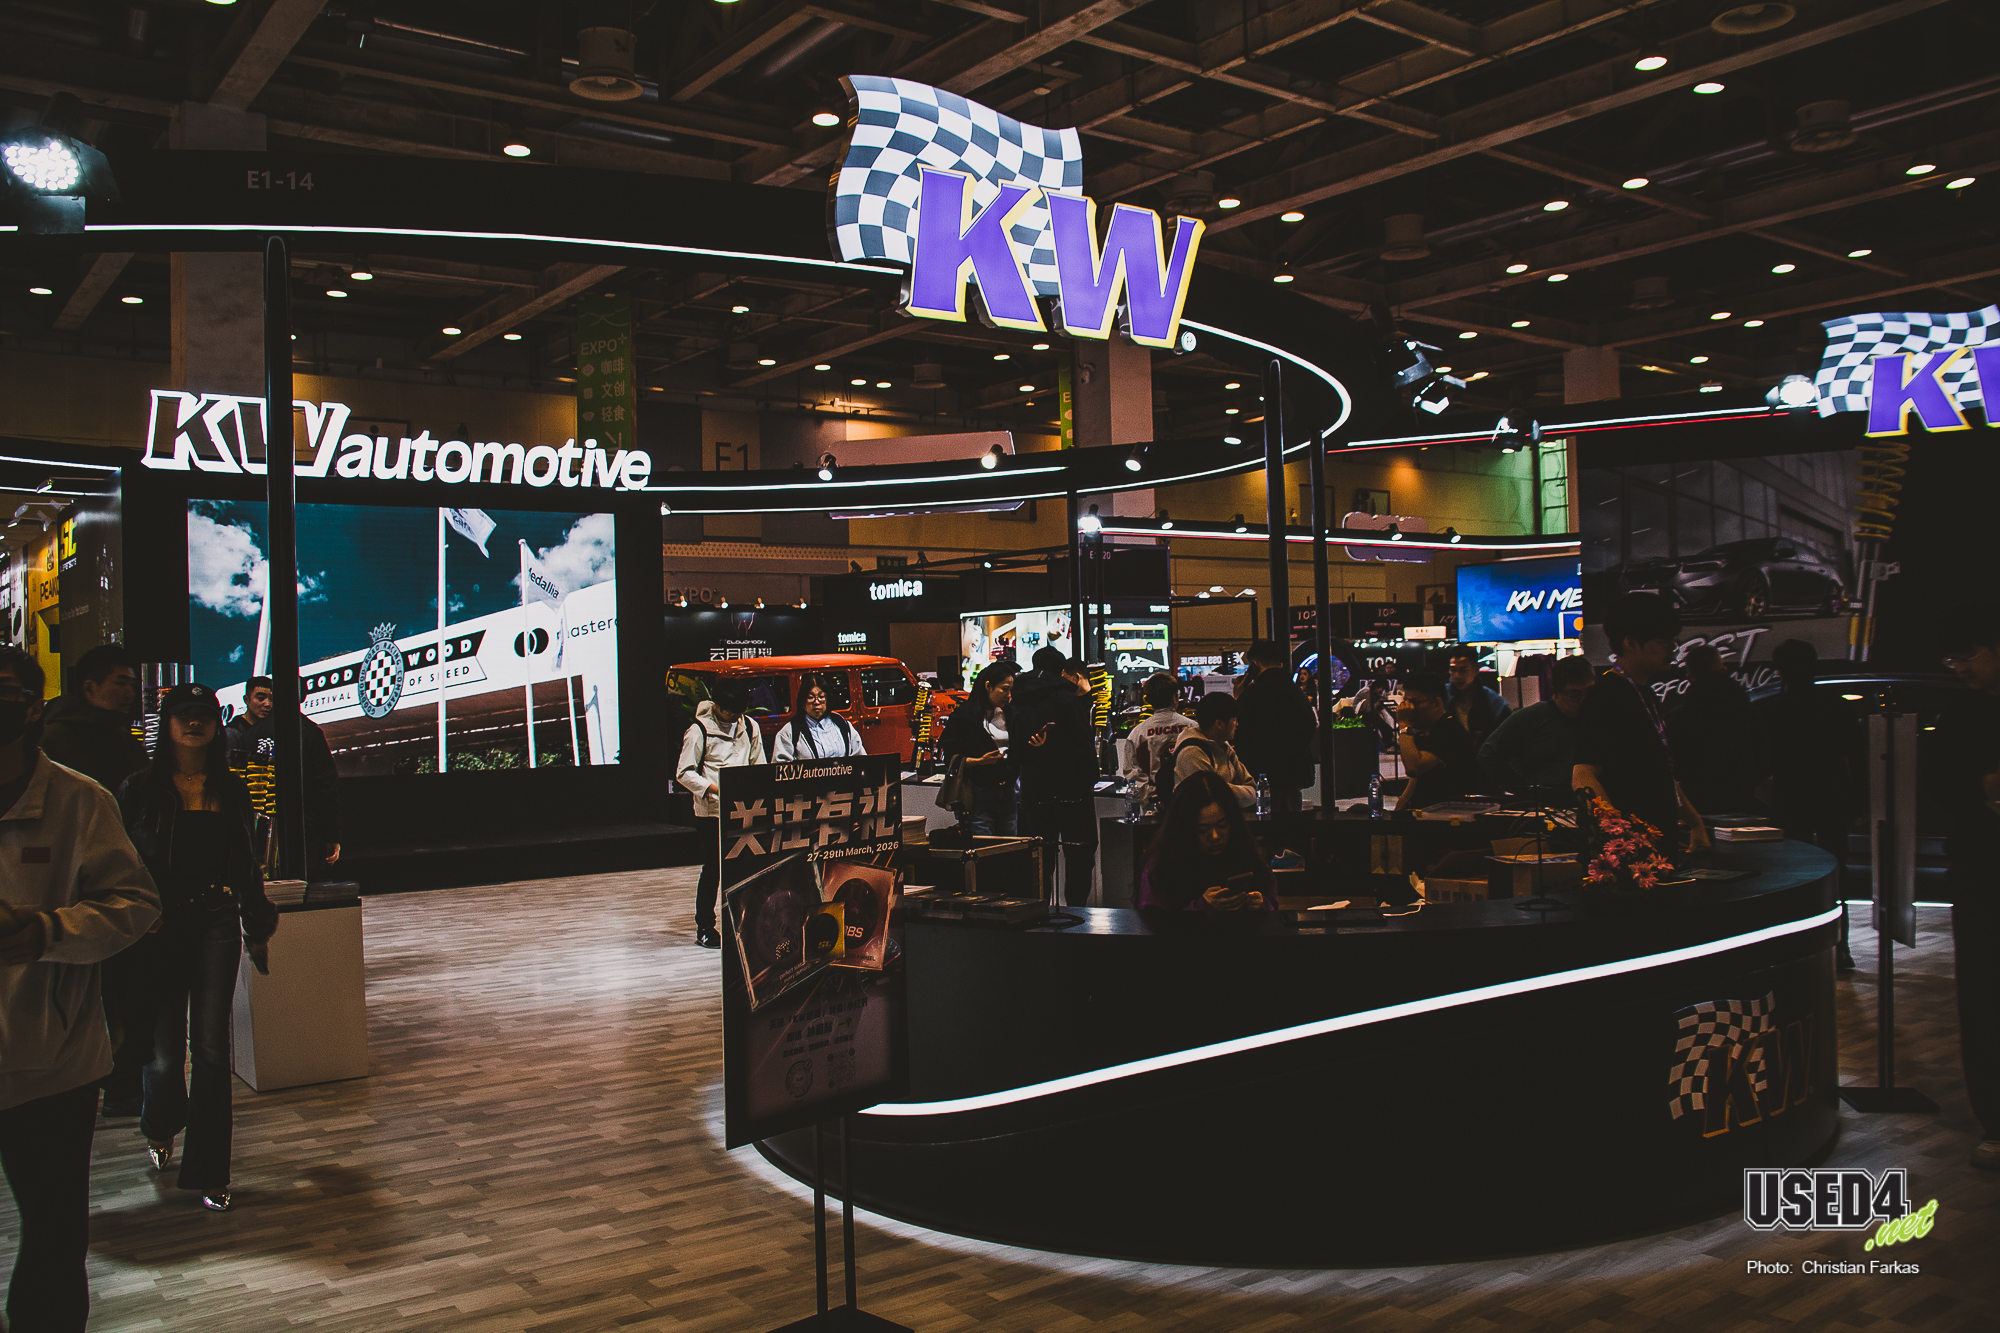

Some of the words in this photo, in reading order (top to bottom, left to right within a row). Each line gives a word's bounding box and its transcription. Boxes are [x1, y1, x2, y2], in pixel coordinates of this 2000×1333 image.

[247, 170, 315, 190] E1-14
[905, 162, 1207, 350] KW
[601, 380, 626, 399] 文创
[1863, 343, 2000, 438] K
[601, 404, 626, 422] 轻食
[141, 388, 352, 478] KW
[335, 429, 653, 492] automotive
[1089, 550, 1112, 560] E20
[869, 578, 924, 601] tomica
[1505, 588, 1546, 613] KW
[837, 631, 867, 643] tomica
[306, 668, 354, 691] GOOD
[407, 639, 472, 667] WOOD
[304, 691, 351, 709] FESTIVAL
[409, 676, 423, 687] OF
[430, 665, 470, 682] SEED
[1147, 724, 1189, 738] DUCAT
[775, 764, 804, 782] KW
[803, 764, 853, 779] automotive
[724, 785, 895, 860] 关注有礼
[806, 849, 844, 862] 27-29th
[845, 846, 874, 858] March,
[876, 841, 899, 853] 2026
[1703, 1013, 1815, 1139] KW
